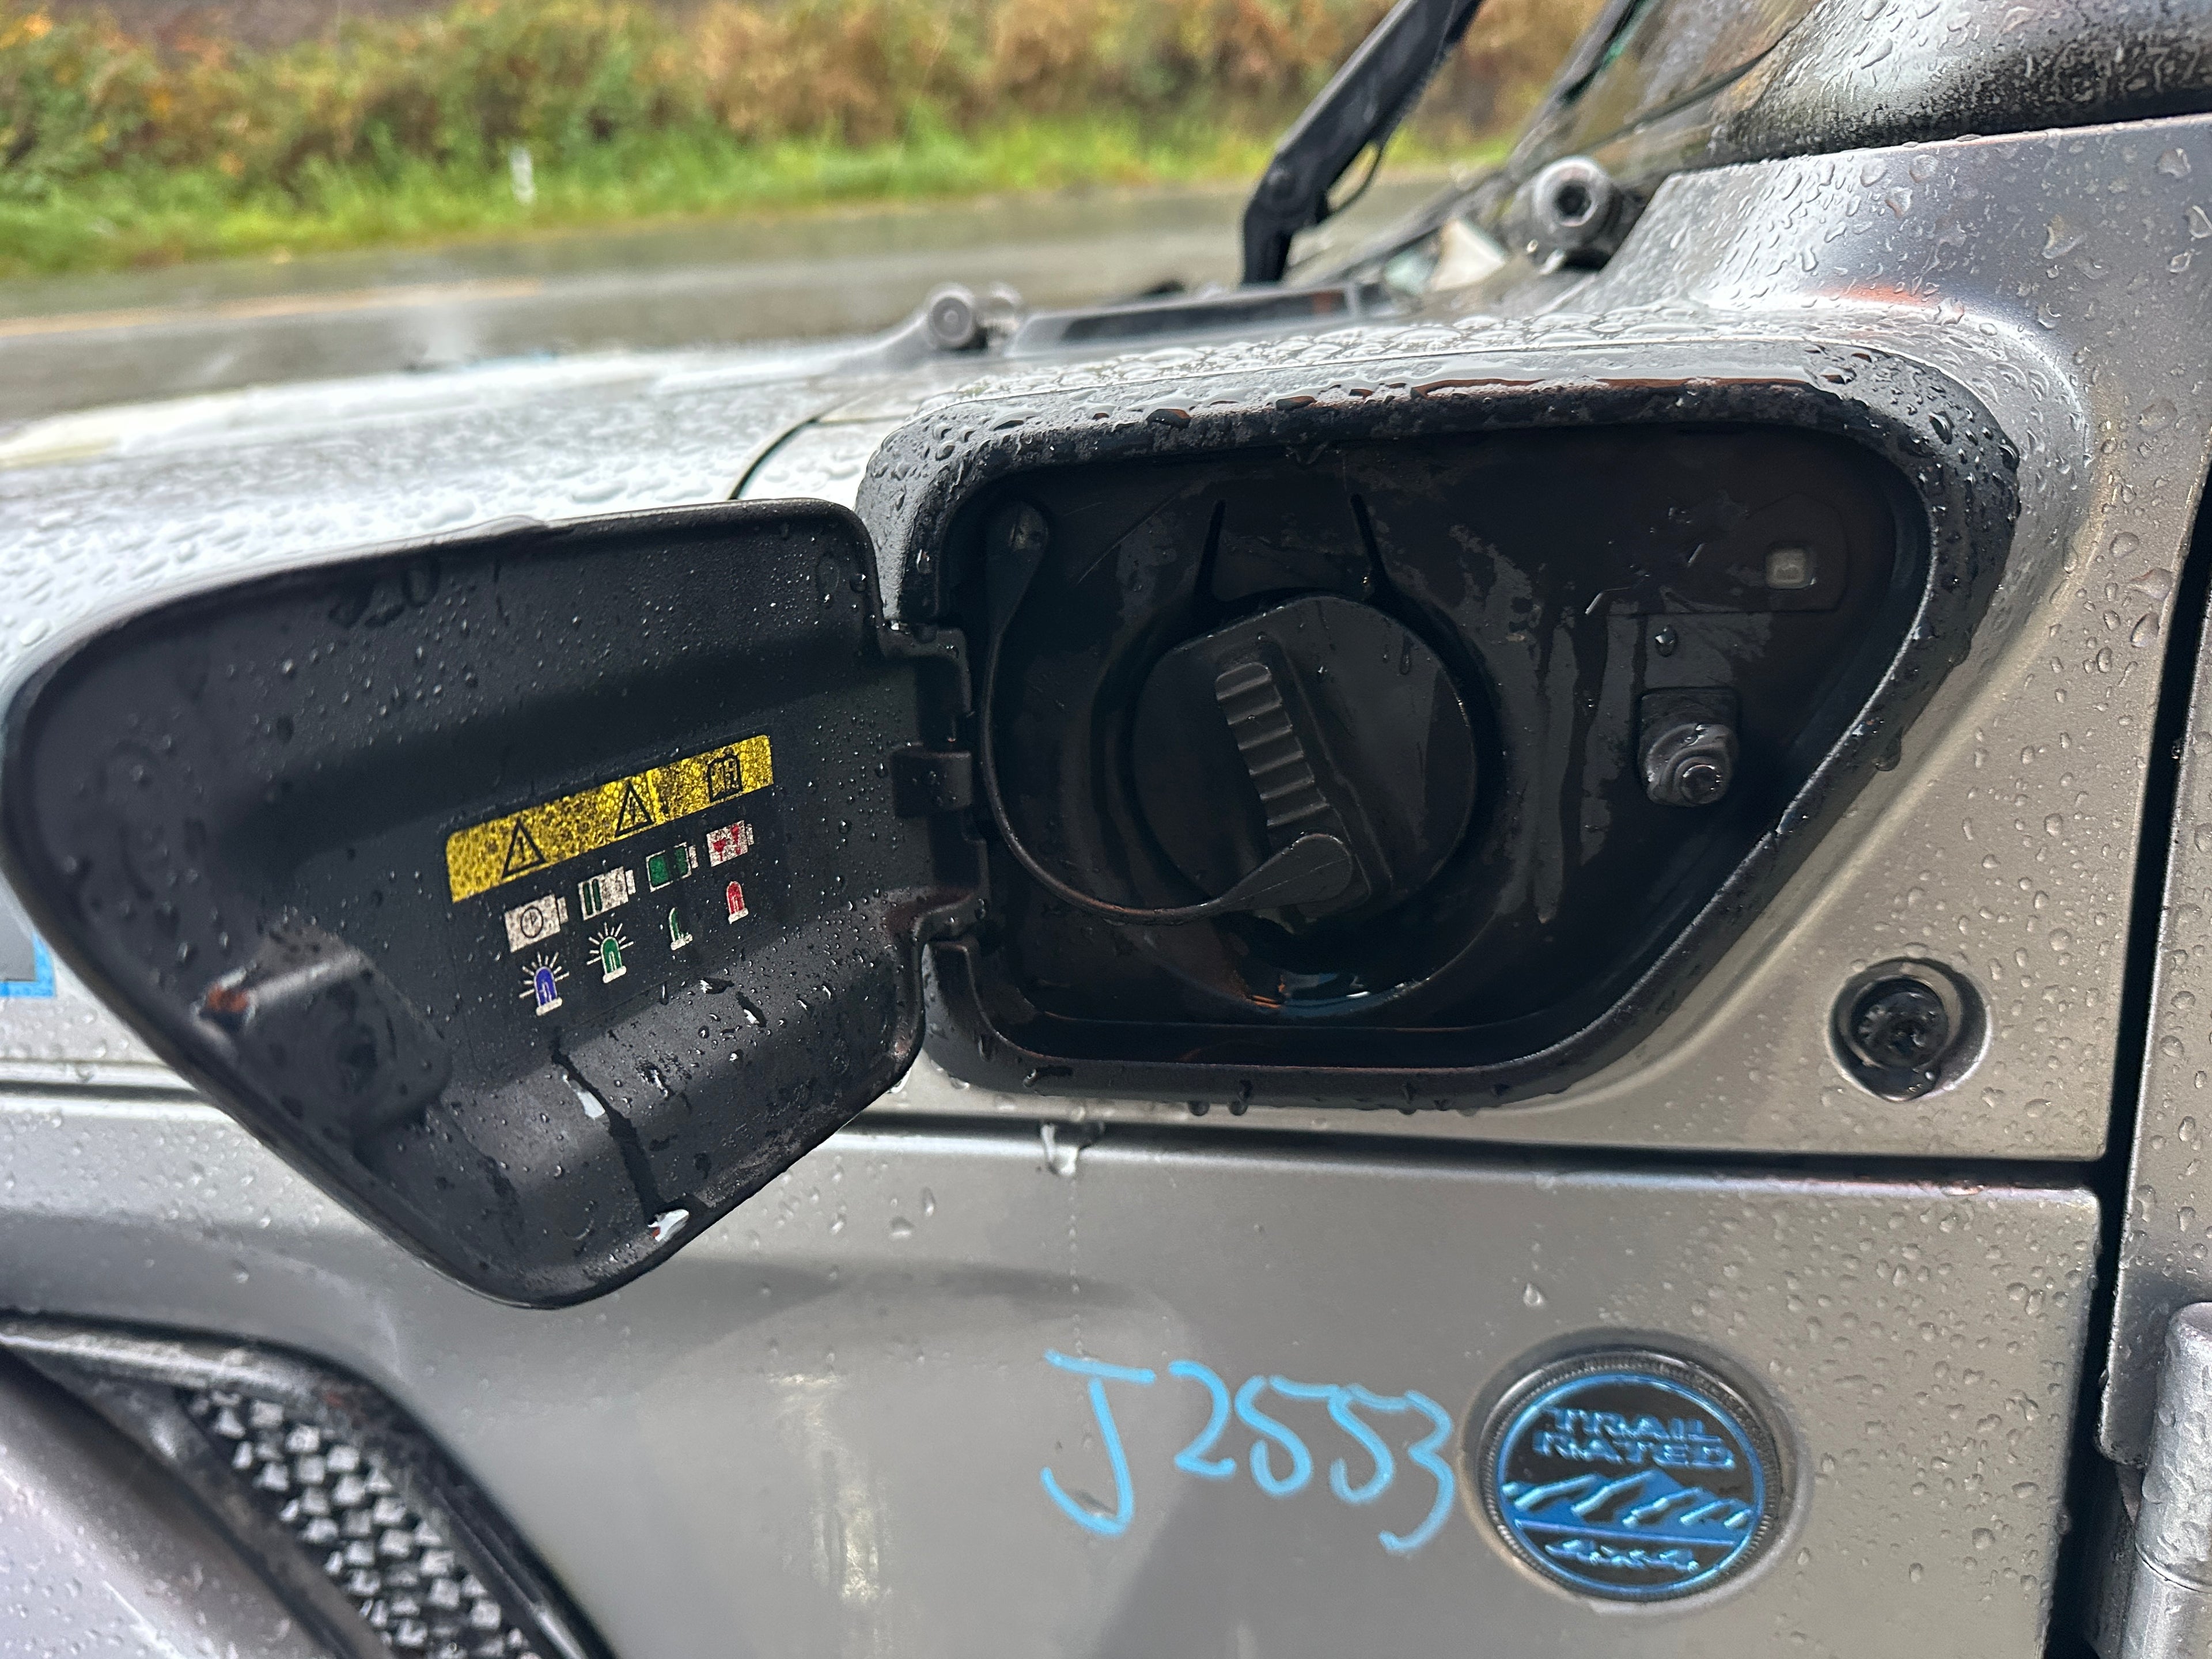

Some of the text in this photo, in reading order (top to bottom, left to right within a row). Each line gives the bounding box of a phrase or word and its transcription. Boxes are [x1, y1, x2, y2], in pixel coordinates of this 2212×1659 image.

[1543, 1408, 1722, 1442] TRAIL
[1041, 1350, 1455, 1553] J2553
[1533, 1430, 1735, 1469] RATED
